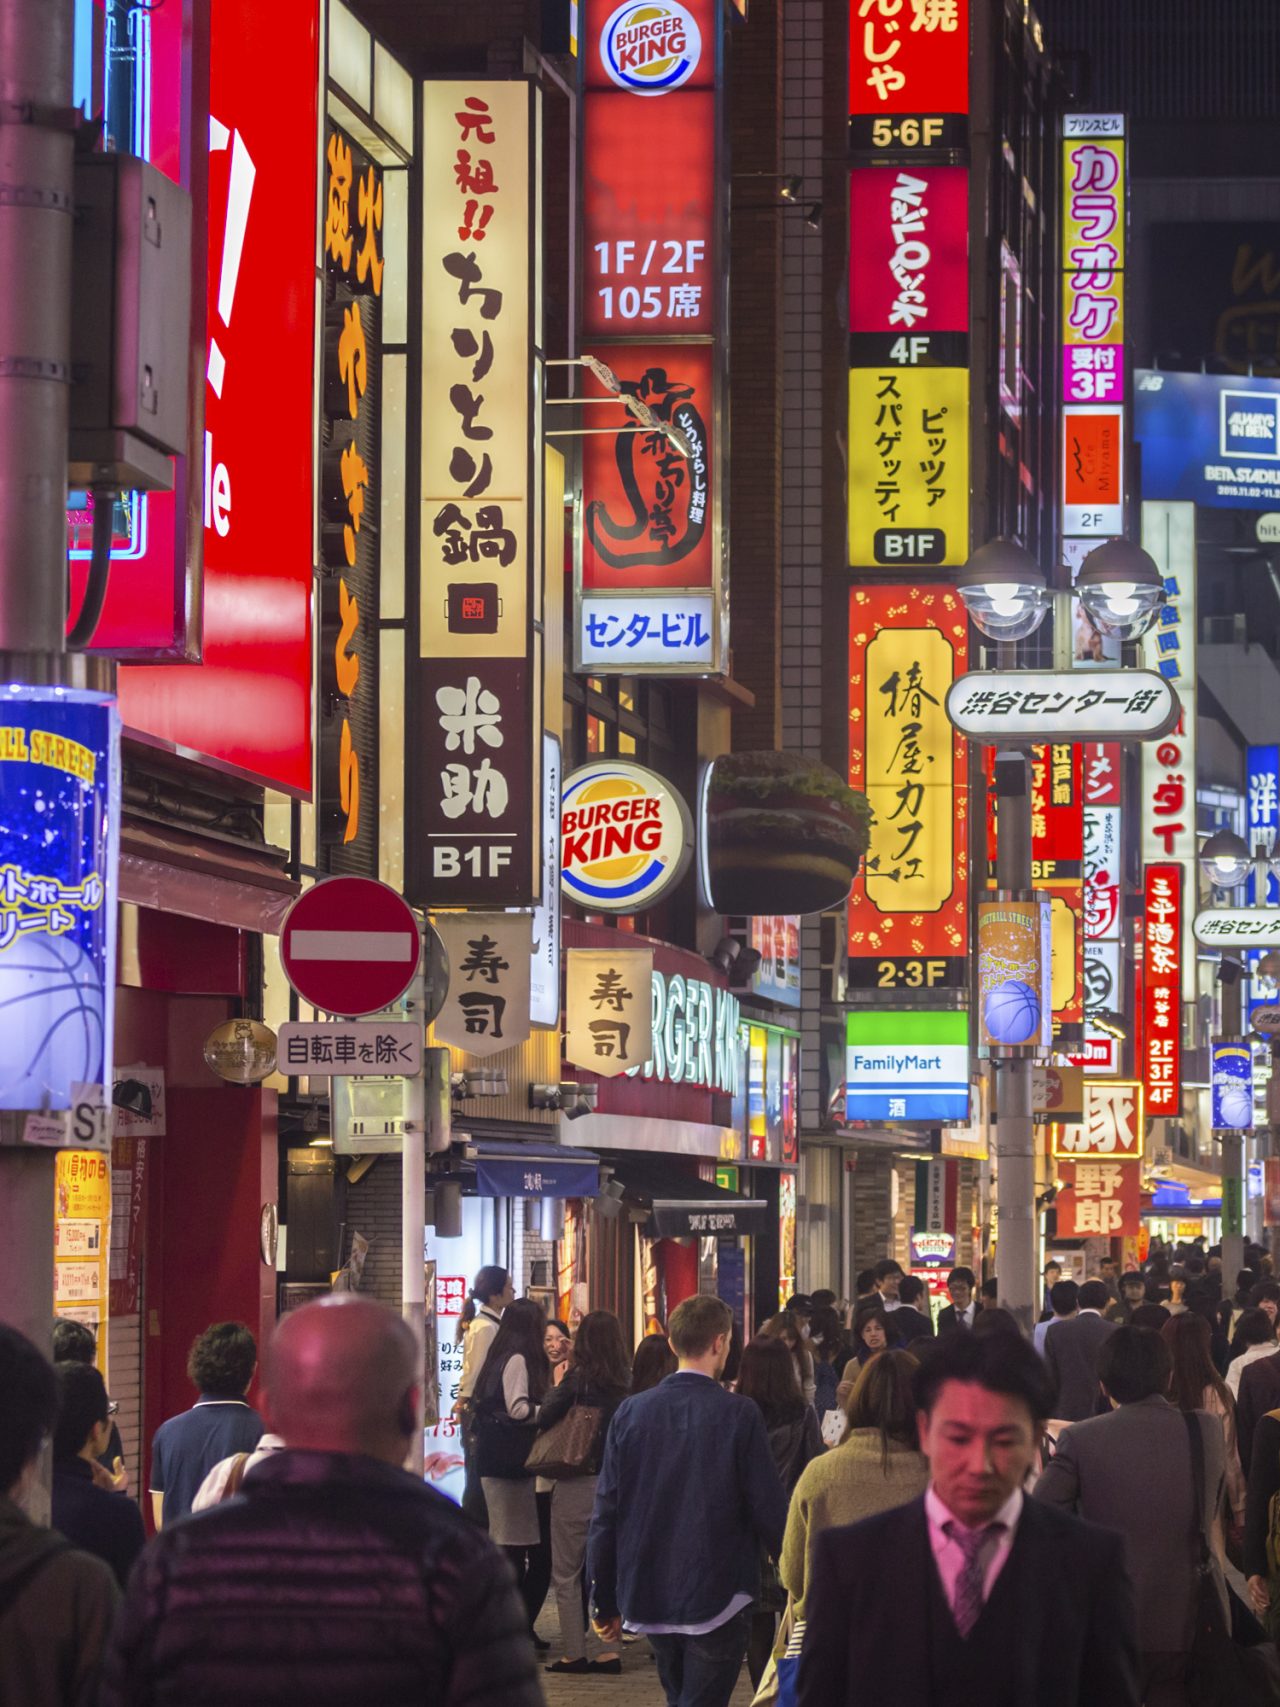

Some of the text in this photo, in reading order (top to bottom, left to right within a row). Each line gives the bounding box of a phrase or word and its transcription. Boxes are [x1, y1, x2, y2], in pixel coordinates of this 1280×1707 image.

[616, 17, 683, 49] BURGER
[617, 32, 687, 72] KING
[1069, 119, 1119, 131] プリンスビル
[1070, 145, 1119, 339] カラオケ
[598, 283, 702, 319] 105席
[889, 336, 930, 363] 4F
[1071, 348, 1115, 370] 受付
[1071, 373, 1115, 399] 3F
[1228, 411, 1275, 427] ALWAYS
[1230, 425, 1273, 439] IN BETA
[875, 375, 902, 522] スパゲッティ
[920, 407, 948, 507] ピッツァ
[1204, 465, 1236, 482] BETA
[1081, 514, 1103, 528] 2F
[884, 535, 935, 557] B1F
[586, 613, 711, 647] センタービル
[960, 688, 1163, 715] 渋谷センター街
[0, 727, 29, 761] LL
[435, 676, 509, 818] 米助
[875, 661, 942, 880] 椿屋カフェ
[562, 797, 661, 835] BURGER
[562, 820, 663, 868] KING
[433, 846, 512, 877] B1F
[459, 934, 510, 1039] 寿司
[588, 968, 633, 1060] 寿司
[288, 1034, 413, 1064] 自転車を除く
[1150, 1040, 1174, 1056] 2F
[853, 1055, 941, 1074] FamilyMart
[1150, 1064, 1174, 1080] 3F
[889, 1099, 906, 1117] 酒
[1150, 1088, 1174, 1104] 4F
[1073, 1163, 1123, 1234] 野郎
